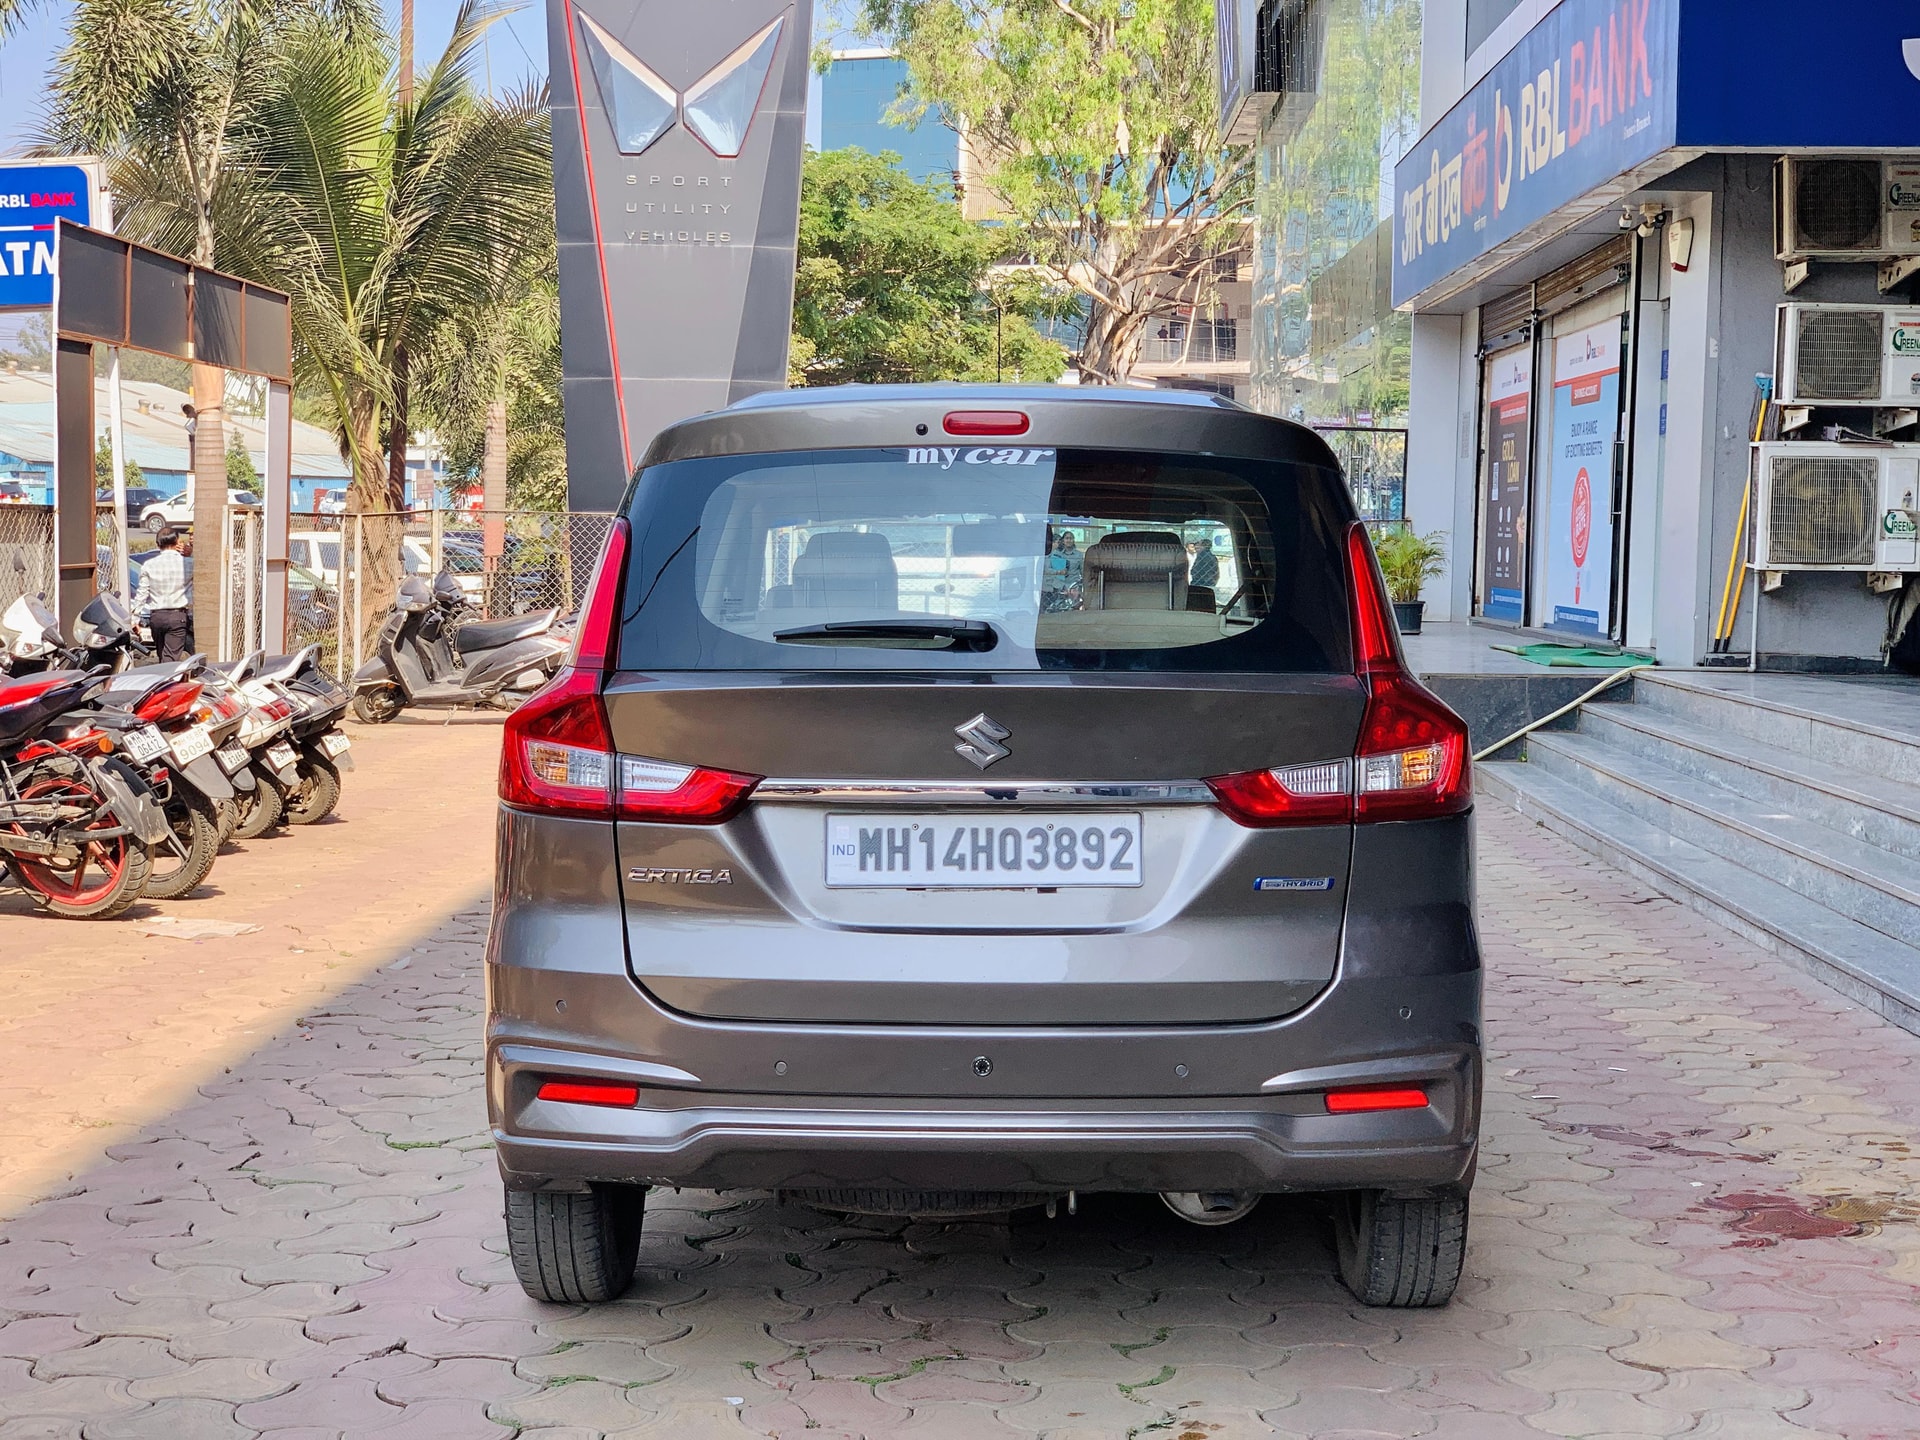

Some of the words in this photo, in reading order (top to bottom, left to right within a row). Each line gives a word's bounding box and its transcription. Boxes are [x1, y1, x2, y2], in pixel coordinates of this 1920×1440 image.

[1520, 59, 1566, 181] RBL
[1568, 0, 1652, 148] BANK
[625, 174, 732, 187] SPORT
[0, 193, 30, 208] RBL
[30, 191, 76, 208] BANK
[625, 202, 732, 214] UTILITY
[624, 230, 732, 243] VEHICLES
[907, 447, 960, 470] my
[965, 447, 1054, 466] car
[180, 738, 210, 760] 9094
[832, 844, 856, 856] IND
[859, 827, 1134, 871] MH14HQ3892
[627, 867, 734, 884] ERTIGA
